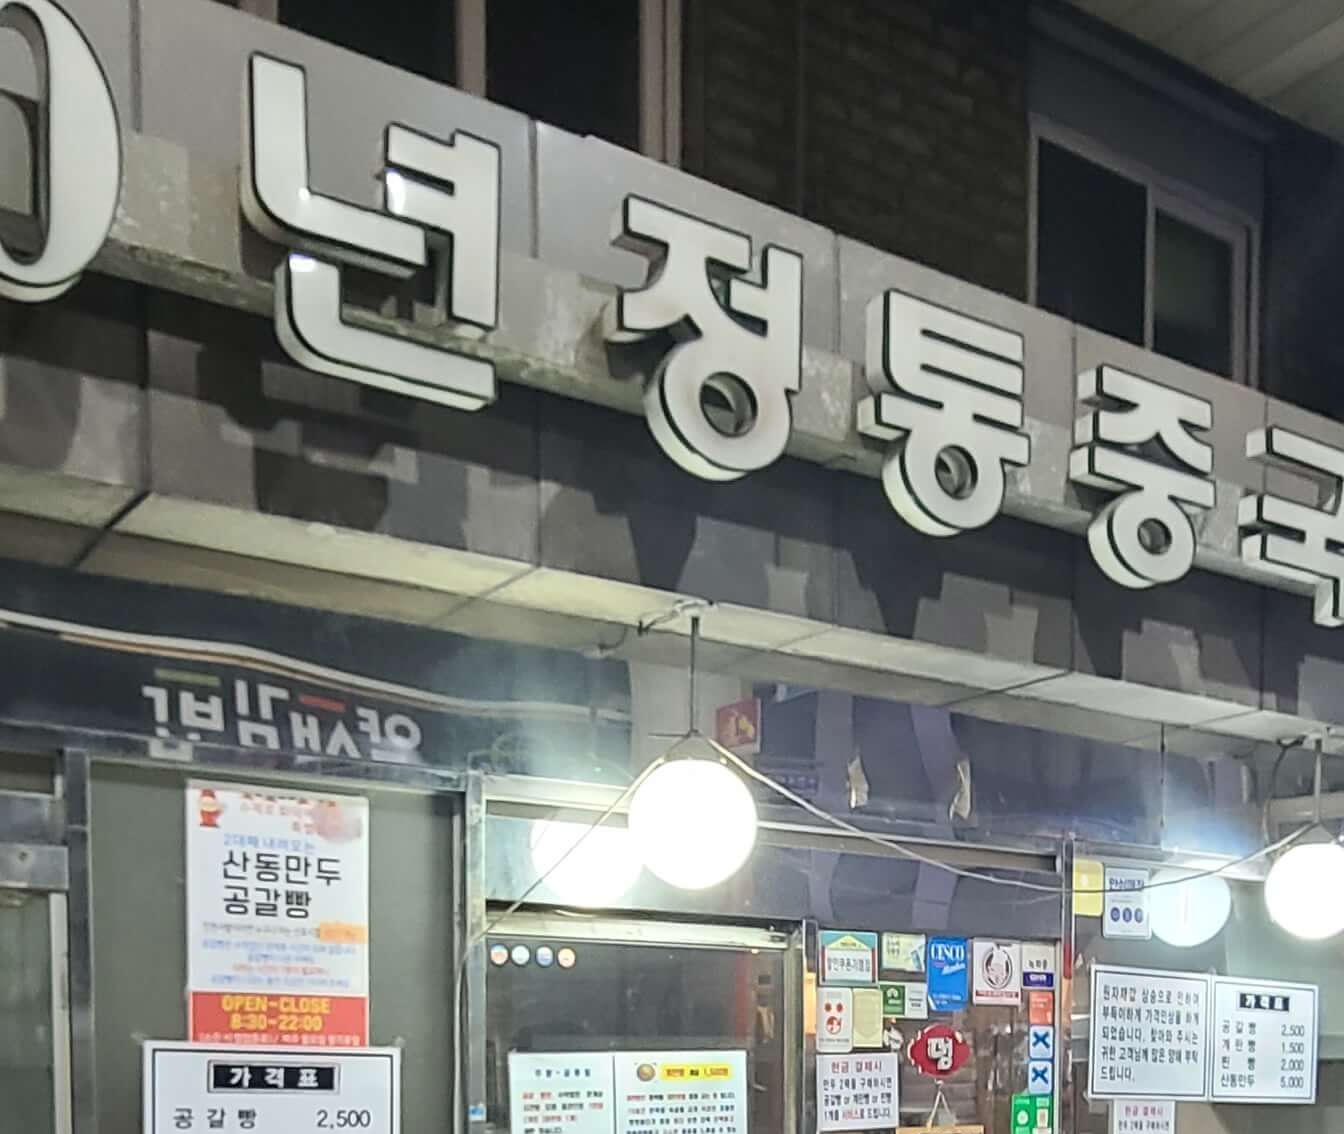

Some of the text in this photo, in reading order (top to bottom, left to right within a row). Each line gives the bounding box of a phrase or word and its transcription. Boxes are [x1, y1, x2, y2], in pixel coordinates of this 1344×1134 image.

[222, 850, 342, 886] 산동만두
[222, 885, 312, 919] 공갈빵
[317, 1110, 371, 1129] 2,500
